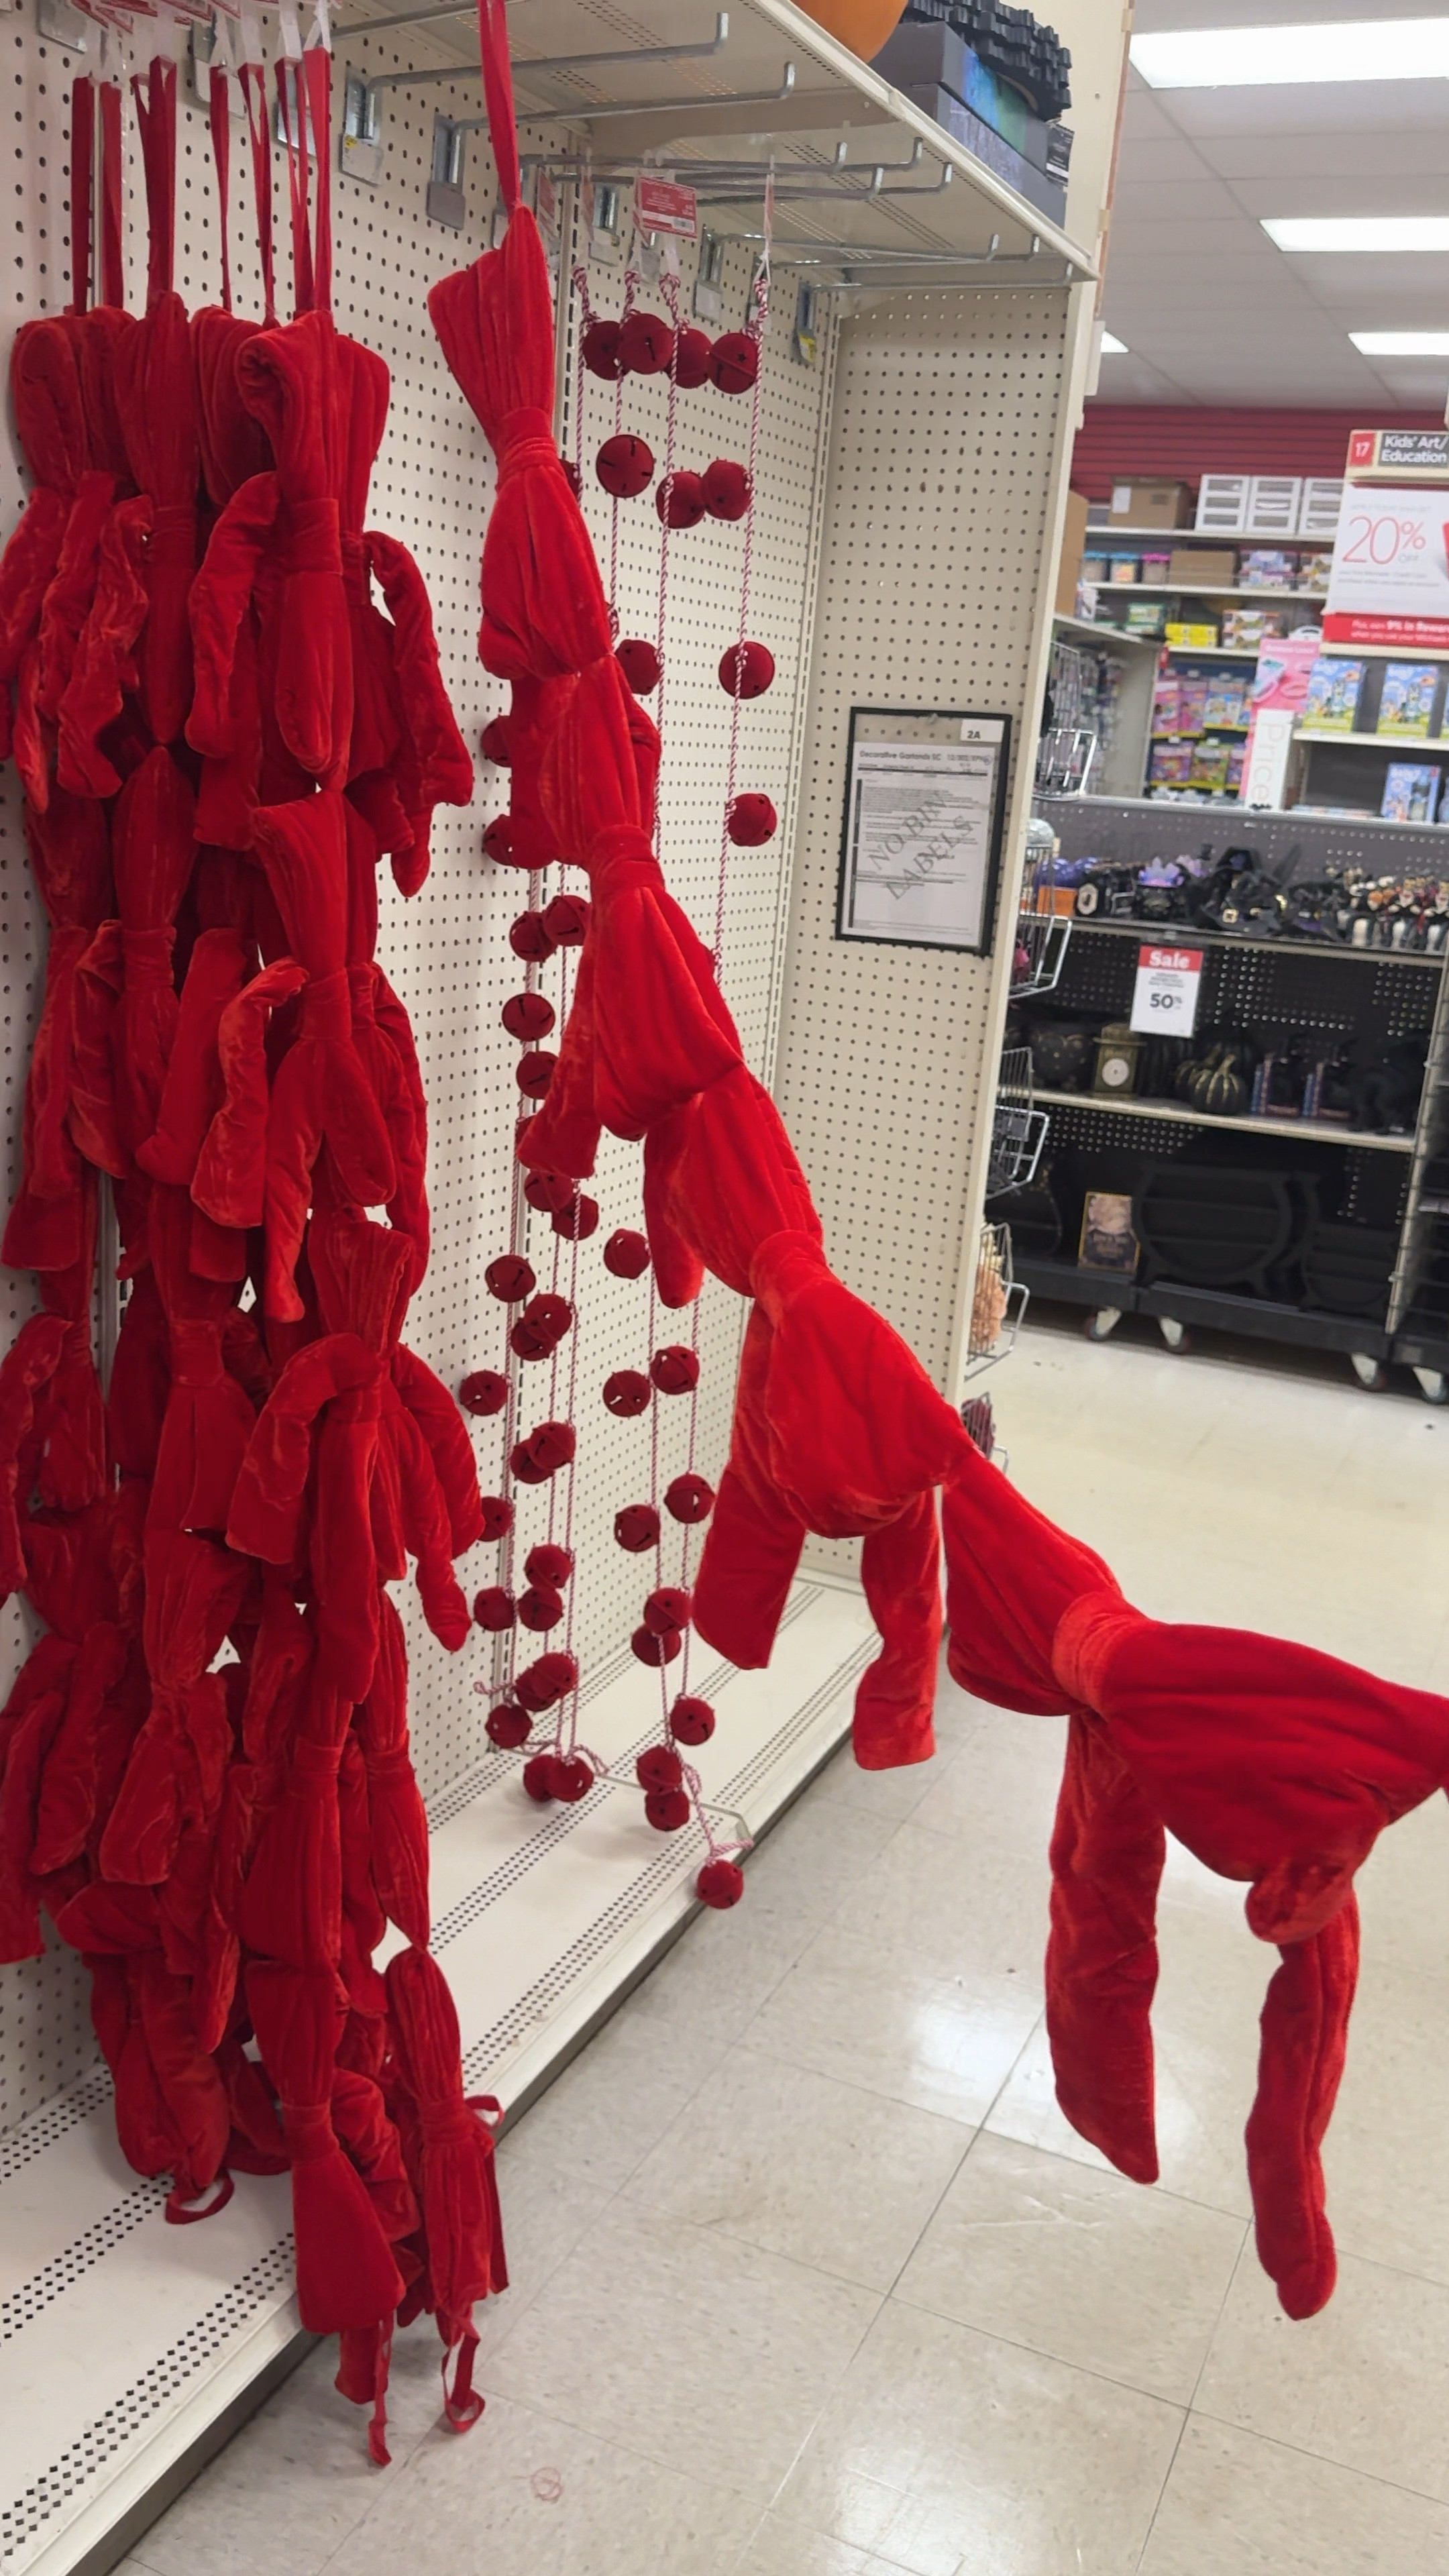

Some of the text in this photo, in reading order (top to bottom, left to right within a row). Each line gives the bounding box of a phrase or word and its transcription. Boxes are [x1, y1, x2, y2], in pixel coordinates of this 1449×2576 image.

[1355, 442, 1370, 457] 17
[1385, 435, 1449, 450] Kids' Art/
[1382, 448, 1447, 463] Education
[1342, 515, 1426, 565] 20%
[967, 731, 981, 739] 2A
[1250, 722, 1285, 800] Price
[868, 834, 905, 870] NO
[884, 815, 973, 900] LABELS
[1149, 950, 1190, 969] Sale
